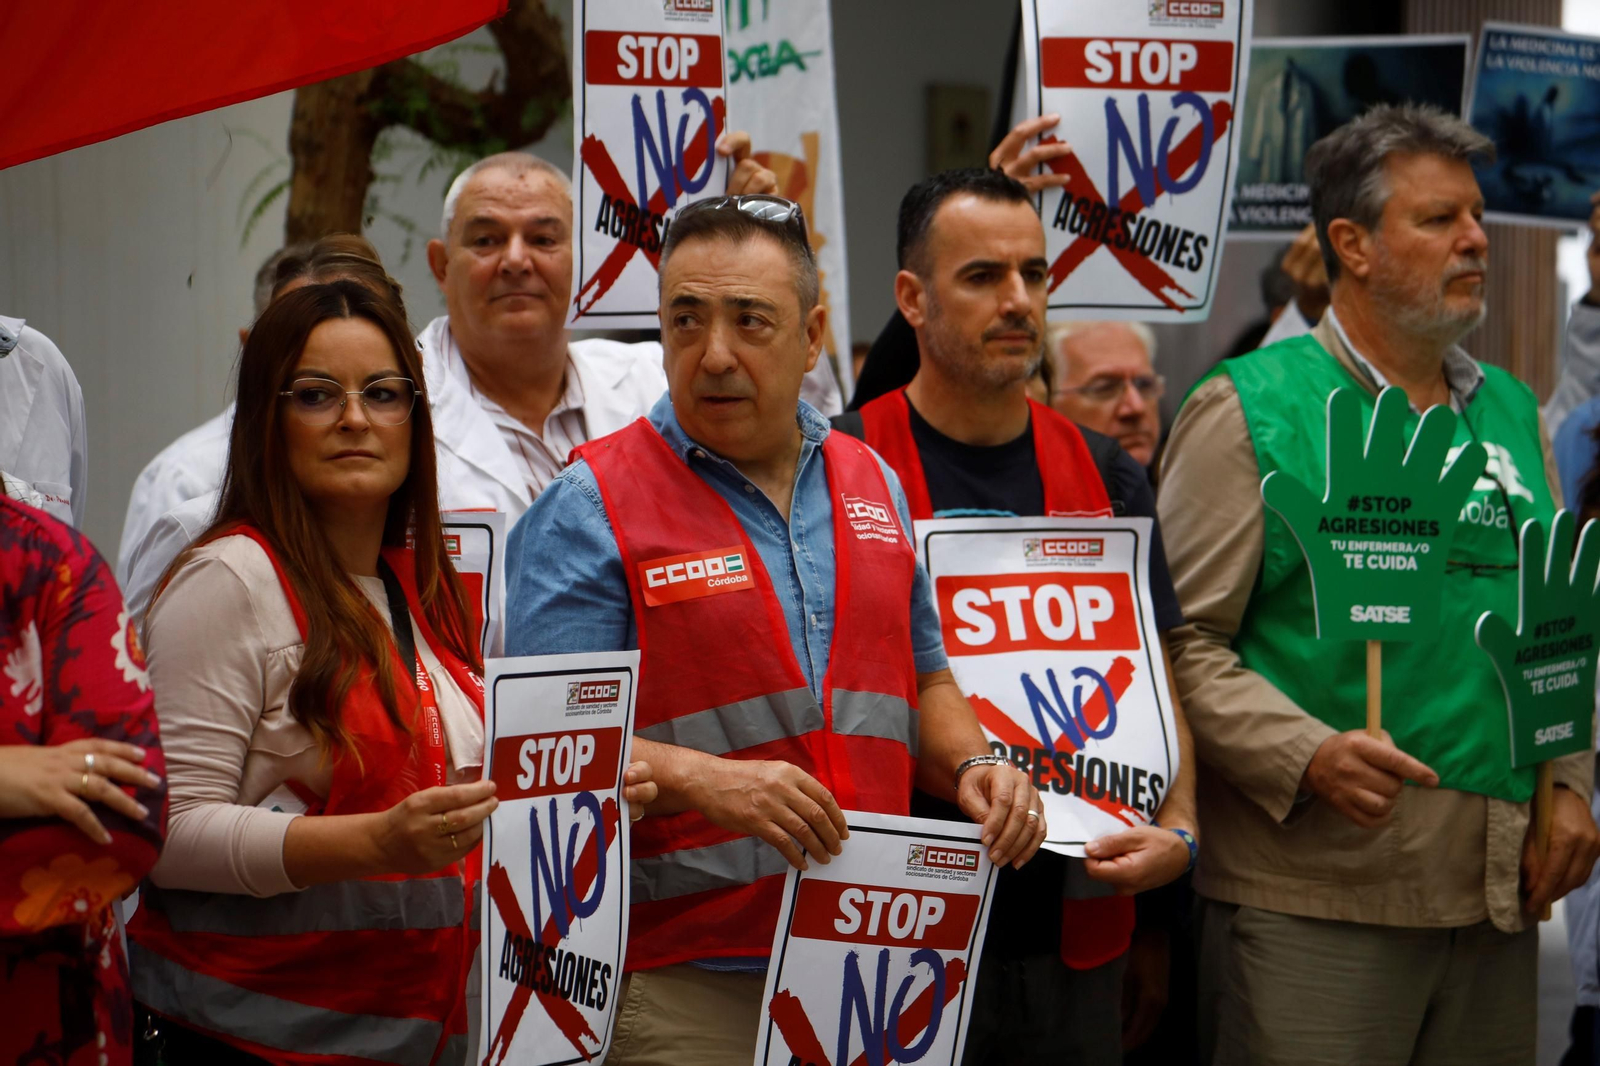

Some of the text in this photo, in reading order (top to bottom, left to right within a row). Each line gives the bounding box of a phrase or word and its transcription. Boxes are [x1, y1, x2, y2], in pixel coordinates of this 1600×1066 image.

[1169, 2, 1211, 15] CCOO
[616, 35, 699, 80] STOP
[1510, 36, 1576, 57] MEDICINA
[1084, 40, 1198, 85] STOP
[1506, 54, 1580, 76] VIOLENCIA
[631, 86, 715, 209] NO
[1104, 91, 1214, 208] NO
[1241, 184, 1311, 200] MEDICIN
[594, 193, 671, 256] AGRESI
[1239, 206, 1313, 223] VIOLENC
[1053, 192, 1208, 272] AGRESIONES
[1347, 496, 1412, 514] #STOP
[1318, 517, 1440, 537] AGRESIONES
[1044, 541, 1089, 554] CCOO
[1330, 540, 1430, 554] TU ENFERMERA/O
[645, 557, 725, 588] CCOO
[1343, 553, 1418, 571] TE CUIDA
[707, 574, 748, 588] Córdoba
[952, 583, 1115, 646] STOP
[1350, 604, 1411, 623] SATSE
[1533, 615, 1576, 639] #STOP
[1515, 632, 1593, 665] AGRESIONES
[1522, 668, 1533, 680] TU
[1530, 671, 1579, 695] TE CUIDA
[580, 685, 611, 699] CCOO
[1020, 666, 1117, 757] NO
[1534, 721, 1574, 745] SATSE
[516, 733, 596, 791] STOP
[989, 741, 1164, 818] RESIONES
[529, 790, 607, 942] NO
[926, 850, 966, 866] CCOO
[905, 871, 941, 879] sociosanitarios
[833, 887, 946, 940] STOP
[499, 930, 612, 1012] AGRESIONES
[836, 947, 946, 1066] NO
